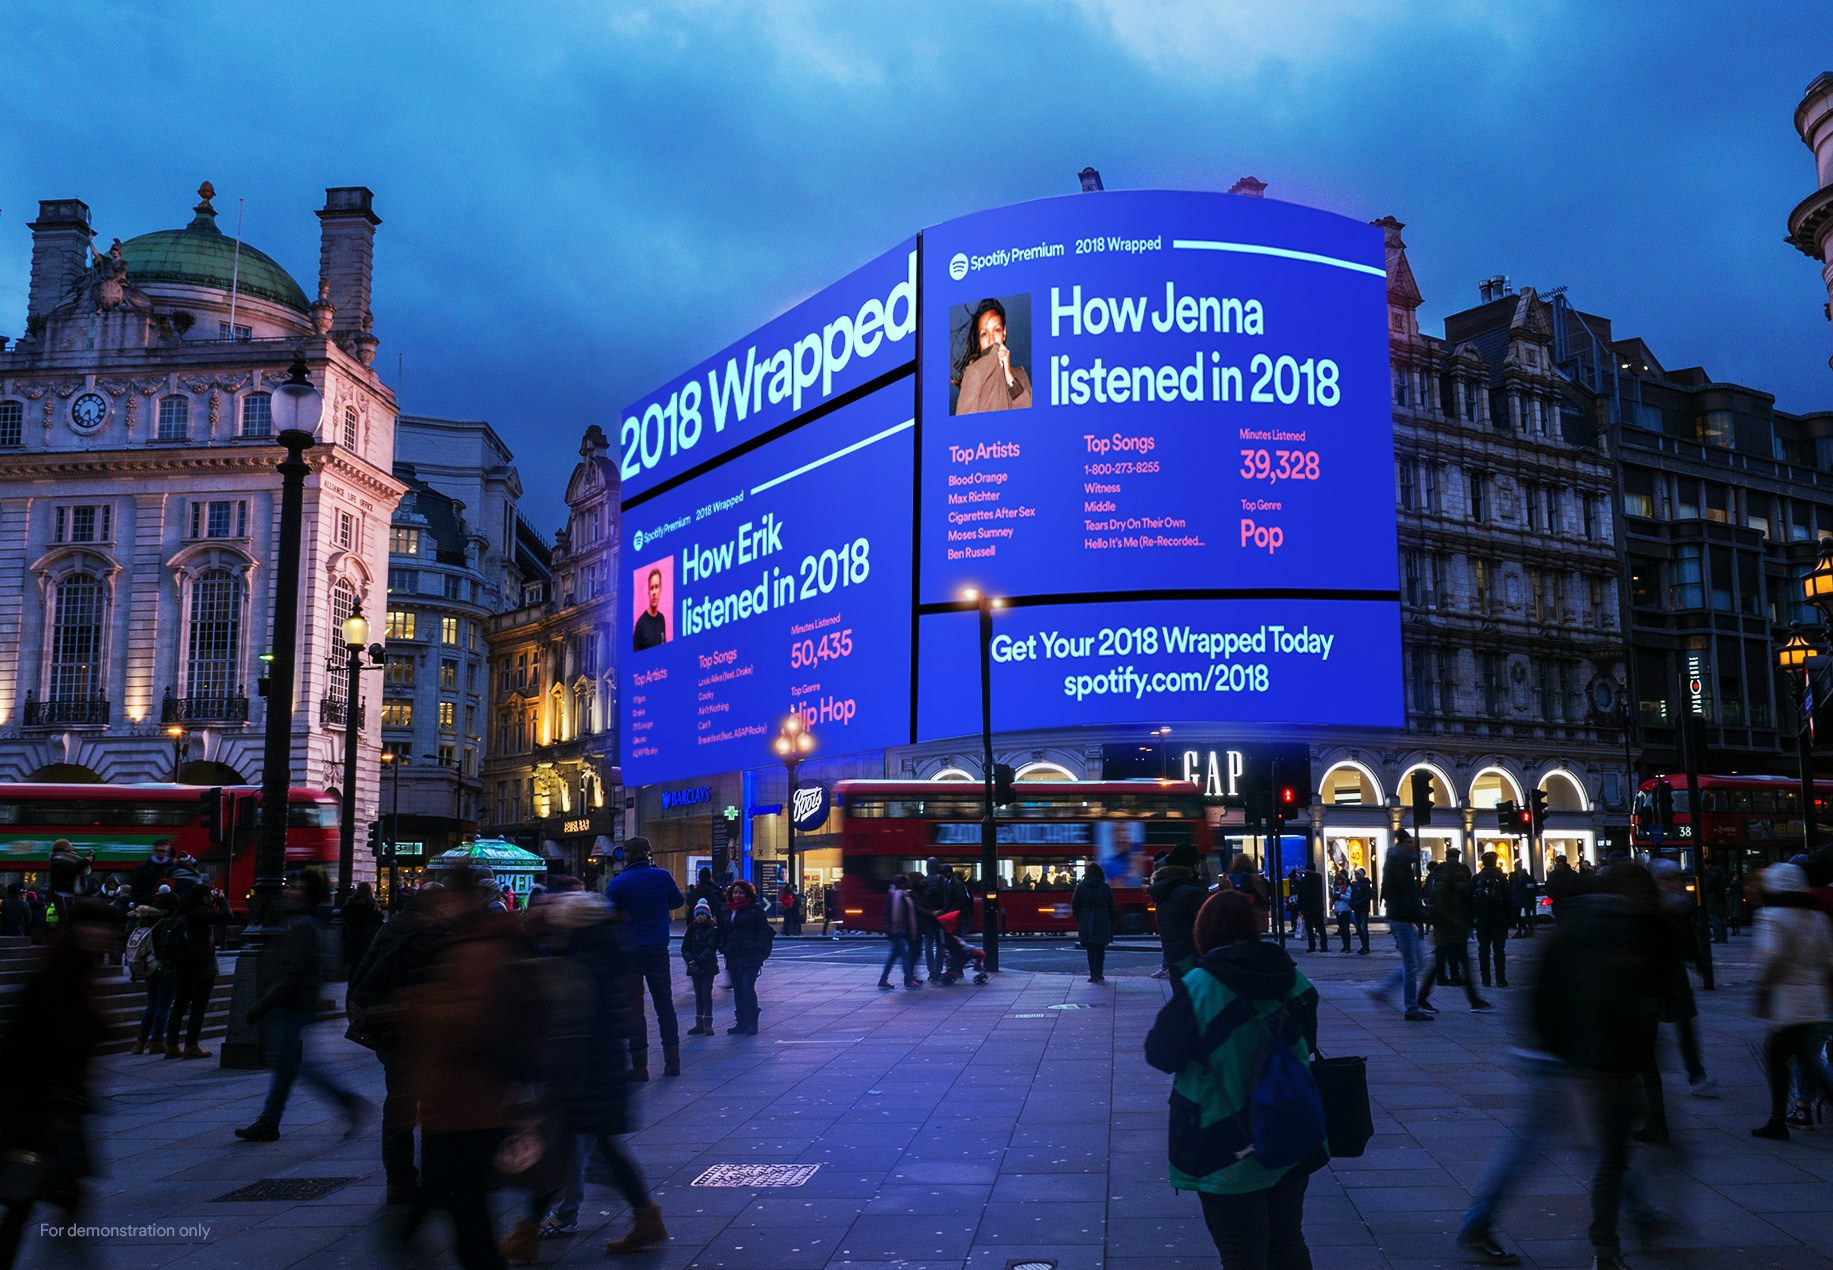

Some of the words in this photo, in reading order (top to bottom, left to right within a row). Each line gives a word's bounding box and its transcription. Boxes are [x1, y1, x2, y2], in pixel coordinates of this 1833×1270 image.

[970, 250, 1011, 271] Spotify
[1012, 241, 1065, 262] Premium
[1075, 237, 1105, 255] 2018
[1107, 235, 1162, 254] Wrapped
[1050, 284, 1148, 337] How
[1151, 281, 1264, 336] Jenna
[620, 380, 703, 482] 2018
[707, 250, 917, 433] Wrapped
[1050, 351, 1204, 406] listened
[1211, 350, 1243, 402] in
[1250, 353, 1341, 407] 2018
[1084, 434, 1111, 455] Top
[1112, 433, 1155, 455] Songs
[1239, 428, 1271, 441] Minutes
[1272, 429, 1306, 442] Listened
[949, 445, 975, 465] Top
[975, 440, 1020, 460] Artists
[1084, 461, 1160, 475] 1-800-273-8255
[1240, 449, 1320, 485] 39,328
[948, 473, 974, 486] Blood
[974, 472, 1008, 485] Orange
[1084, 482, 1121, 494] Witness
[695, 504, 712, 521] 2018
[712, 490, 744, 512] Wrapped
[948, 493, 968, 504] Max
[968, 490, 1000, 503] Richter
[1084, 500, 1116, 513] Middle
[1240, 499, 1257, 512] Top
[1257, 499, 1282, 511] Genre
[948, 510, 994, 525] Cigarettes
[994, 507, 1018, 519] After
[1018, 506, 1036, 518] Sex
[1084, 520, 1109, 531] Tears
[1109, 519, 1126, 532] Dry
[1126, 518, 1141, 530] On
[1141, 517, 1164, 529] Their
[1164, 516, 1186, 528] Own
[643, 526, 664, 544] Spotify
[664, 515, 691, 533] Premium
[948, 530, 977, 541] Moses
[977, 527, 1014, 540] Sumney
[1241, 518, 1284, 554] Pop
[682, 540, 734, 585] How
[738, 512, 783, 565] Erik
[947, 548, 964, 560] Ben
[965, 545, 996, 558] Russell
[1084, 538, 1109, 549] Hello
[1123, 536, 1139, 548] Me
[682, 571, 768, 637] listened
[774, 566, 795, 609] in
[800, 537, 870, 600] 2018
[791, 623, 814, 635] Minutes
[815, 612, 841, 628] Listened
[791, 628, 853, 669] 50,435
[991, 634, 1037, 663] Get
[1039, 630, 1095, 660] Your
[1098, 626, 1159, 656] 2018
[1161, 625, 1266, 659] Wrapped
[1268, 625, 1334, 661] Today
[698, 655, 713, 669] Top
[713, 649, 738, 665] Songs
[633, 673, 646, 687] Top
[646, 668, 668, 683] Artists
[1064, 664, 1269, 701] spotify.com/2018
[791, 686, 802, 697] Top
[802, 683, 821, 694] Genre
[820, 695, 856, 725] Hop
[1183, 750, 1243, 797] GAP
[671, 786, 711, 807] BARCLAYS
[793, 786, 822, 823] Boots
[1679, 826, 1692, 837] 38
